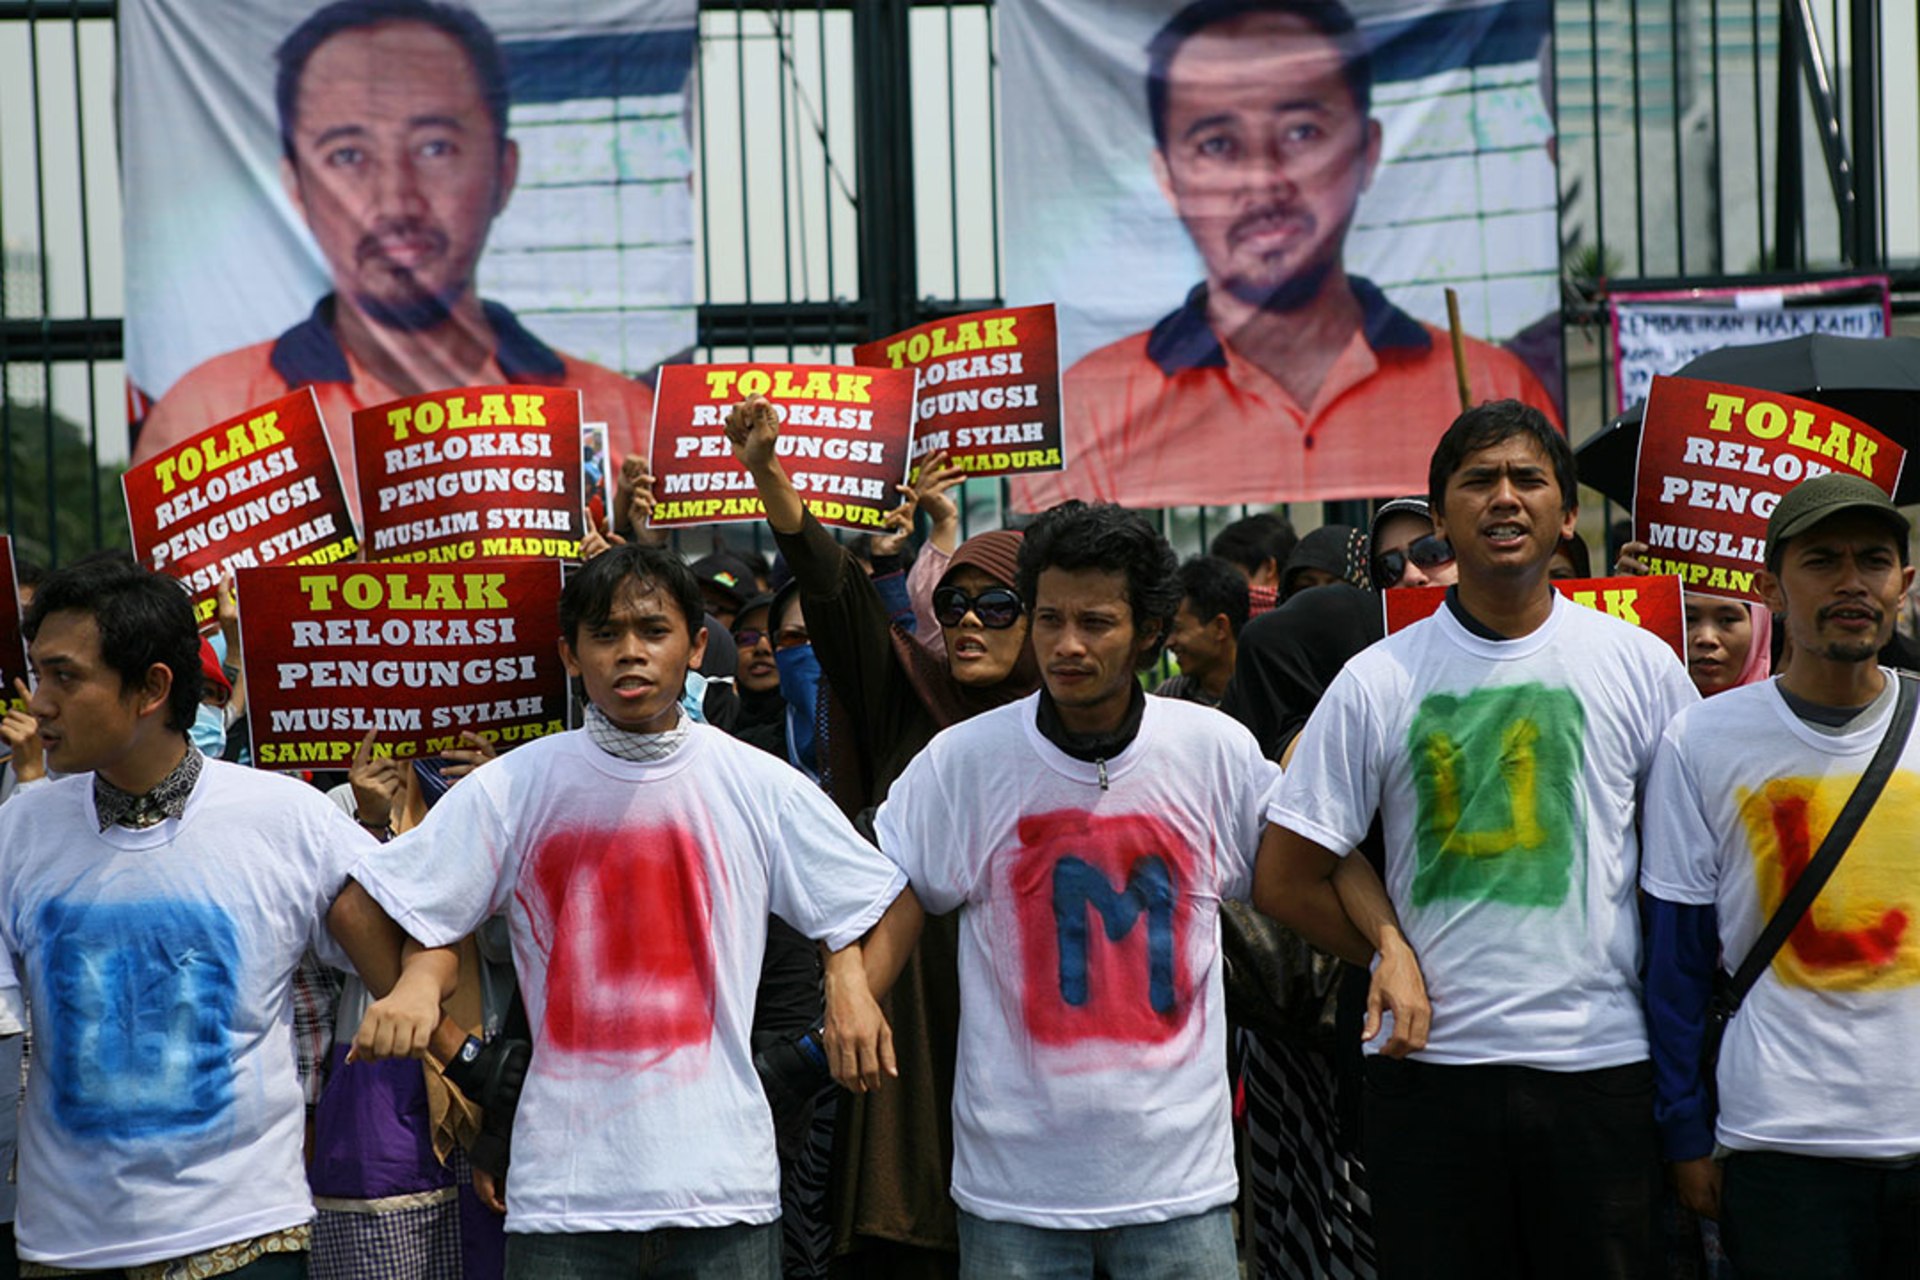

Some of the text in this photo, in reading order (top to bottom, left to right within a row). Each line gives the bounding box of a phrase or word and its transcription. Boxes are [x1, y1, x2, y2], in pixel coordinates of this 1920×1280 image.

[1756, 311, 1807, 336] HAK
[1813, 310, 1864, 333] KAMI
[887, 316, 1018, 370] TOLAK
[706, 369, 873, 405] TOLAK
[916, 351, 1024, 389] LOKASI
[387, 393, 548, 441] TOLAK
[691, 403, 875, 431] RKASI
[917, 384, 1038, 423] GUNGSI
[154, 410, 286, 495] TOLAK
[384, 432, 553, 475] RELOKASI
[674, 434, 885, 465] PEUNGSI
[912, 421, 1044, 459] LIM SYIAH
[1704, 392, 1879, 479] TOLAK
[951, 447, 1062, 473] MADURA
[1682, 436, 1842, 482] RELOK
[155, 447, 299, 531] RELOKASI
[378, 468, 566, 512] PENGUNGSI
[664, 470, 758, 495] MUSLI
[791, 473, 886, 501] SYIAH
[151, 476, 322, 572] PENGUNGSI
[373, 508, 572, 552] MUSLIM SYIAH
[803, 499, 892, 528] ADUR
[180, 513, 337, 597] SLIM SYIAH
[287, 535, 360, 566] DURA
[371, 541, 476, 564] MPANG
[300, 572, 508, 611] TOLAK
[1637, 553, 1762, 596] SAMPAN
[291, 617, 516, 648] RELOKASI
[277, 655, 537, 690] PENGUNGSI
[270, 696, 544, 733] MUSLIM SYIAH
[1766, 795, 1908, 968] L
[1051, 853, 1179, 1016] M
